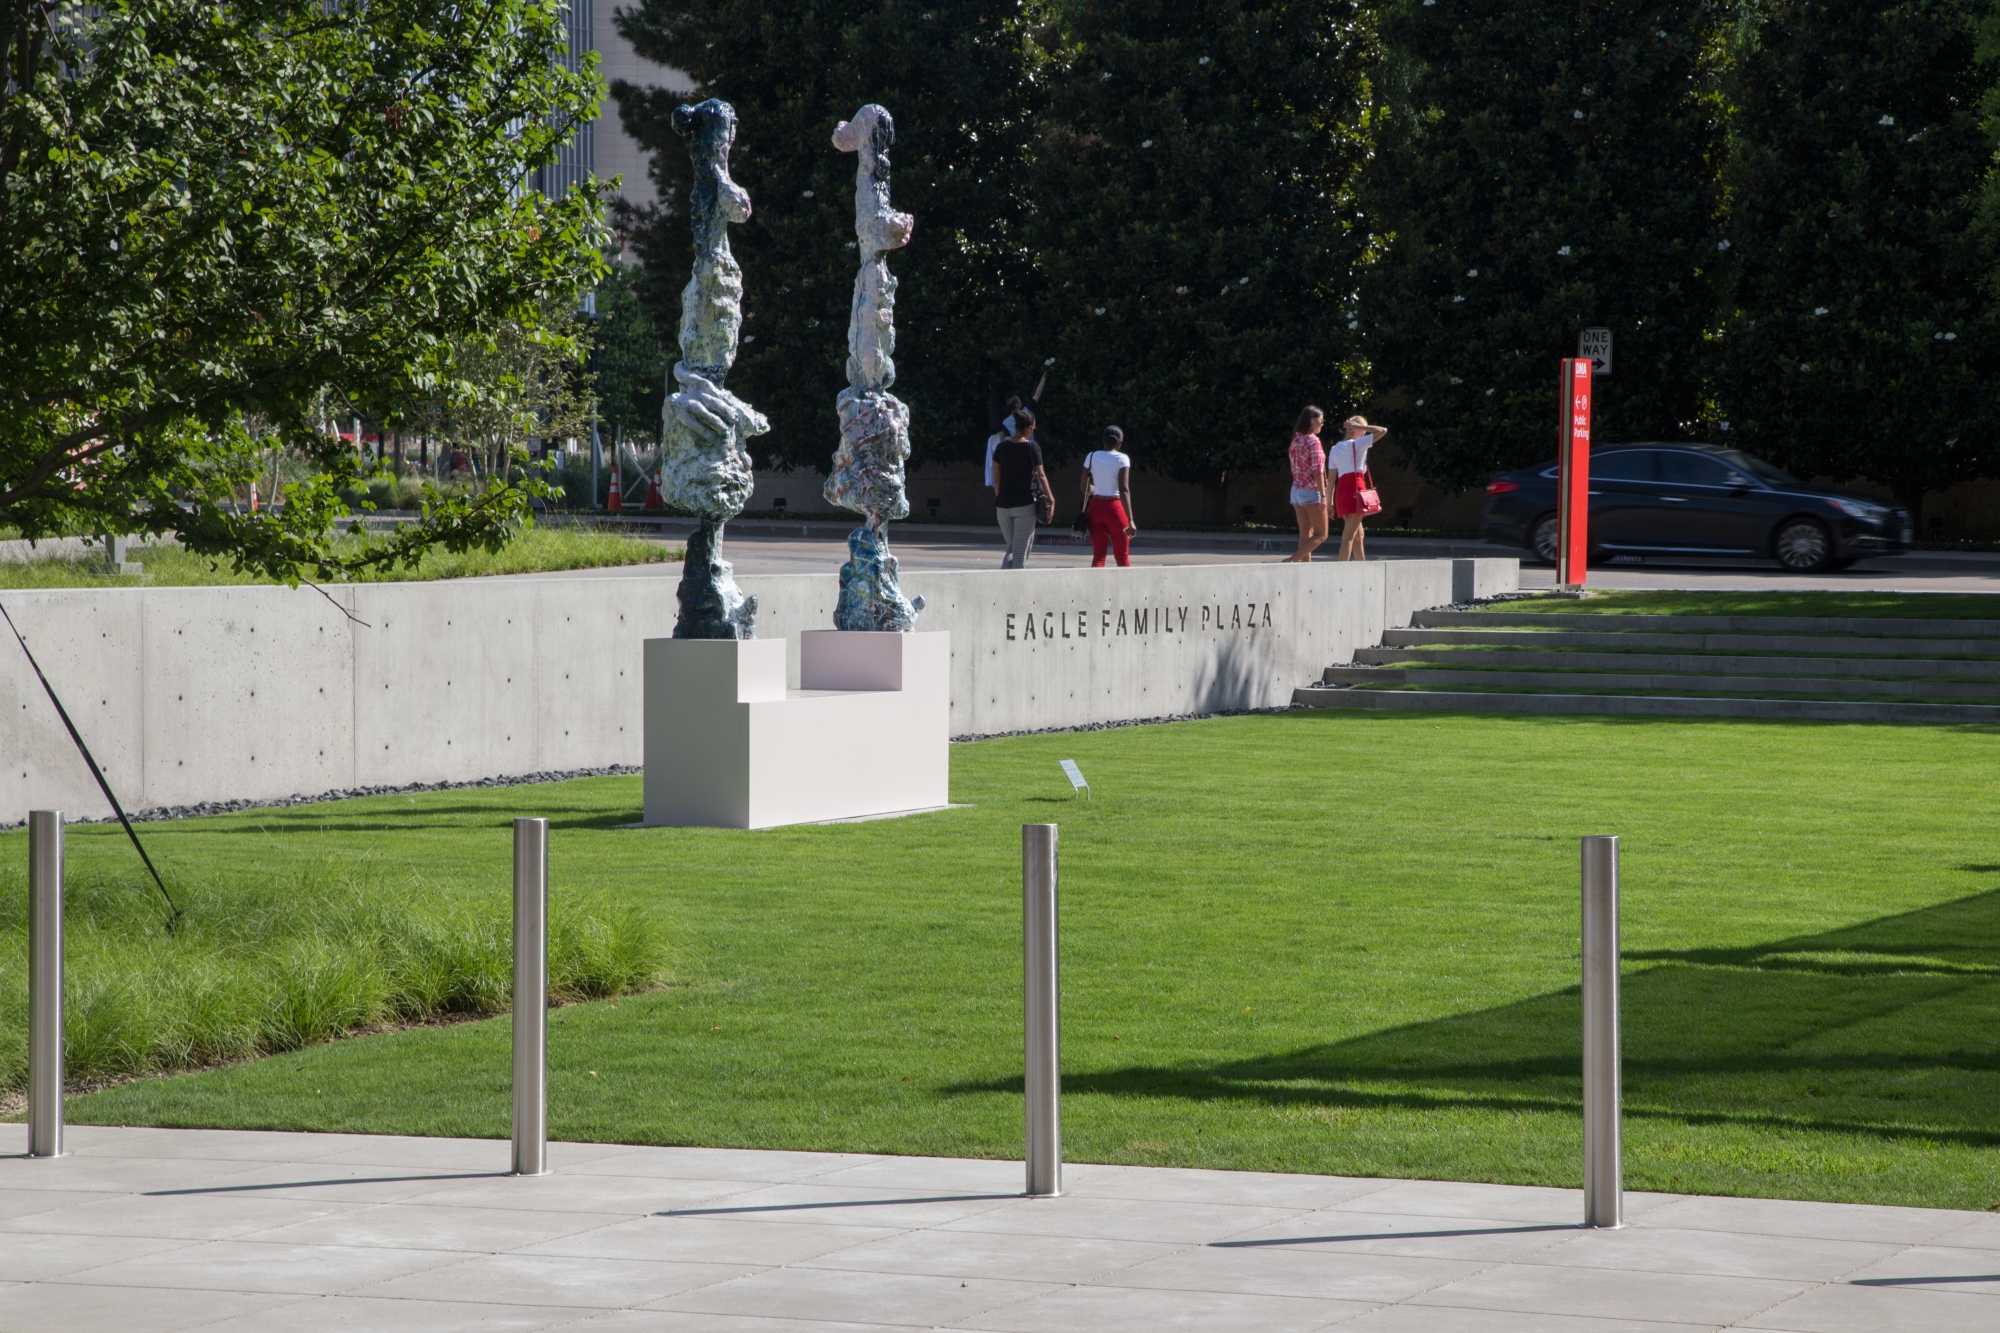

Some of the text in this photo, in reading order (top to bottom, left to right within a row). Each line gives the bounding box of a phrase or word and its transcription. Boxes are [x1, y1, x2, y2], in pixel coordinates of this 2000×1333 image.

[1584, 331, 1609, 343] ONE
[1583, 344, 1609, 356] WAY
[1574, 415, 1586, 425] Public
[1574, 427, 1590, 440] Parking
[1006, 602, 1272, 640] EAGLE FAMILY PLAZA
